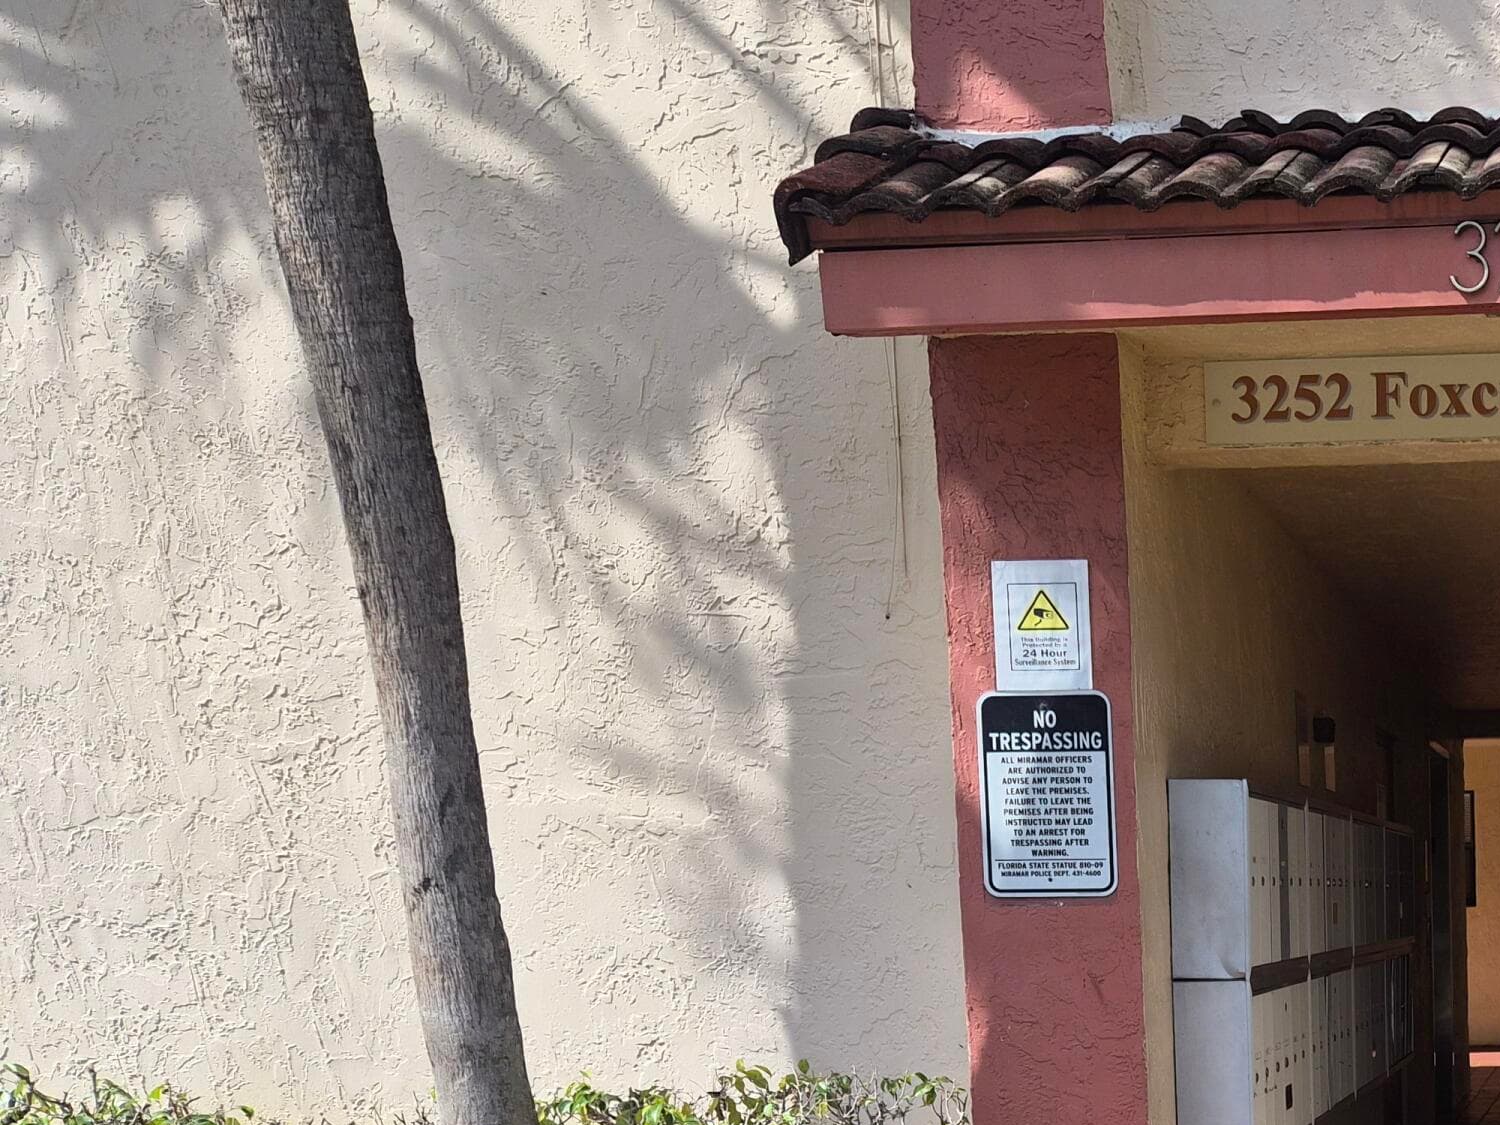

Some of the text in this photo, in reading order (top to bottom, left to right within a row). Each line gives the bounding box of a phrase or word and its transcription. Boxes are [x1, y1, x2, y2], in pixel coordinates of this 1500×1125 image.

[1230, 372, 1354, 424] 3252
[1023, 650, 1037, 658] 24
[1033, 710, 1056, 728] NO
[989, 731, 1102, 750] TRESPASSING
[1032, 849, 1069, 857] WARNING.
